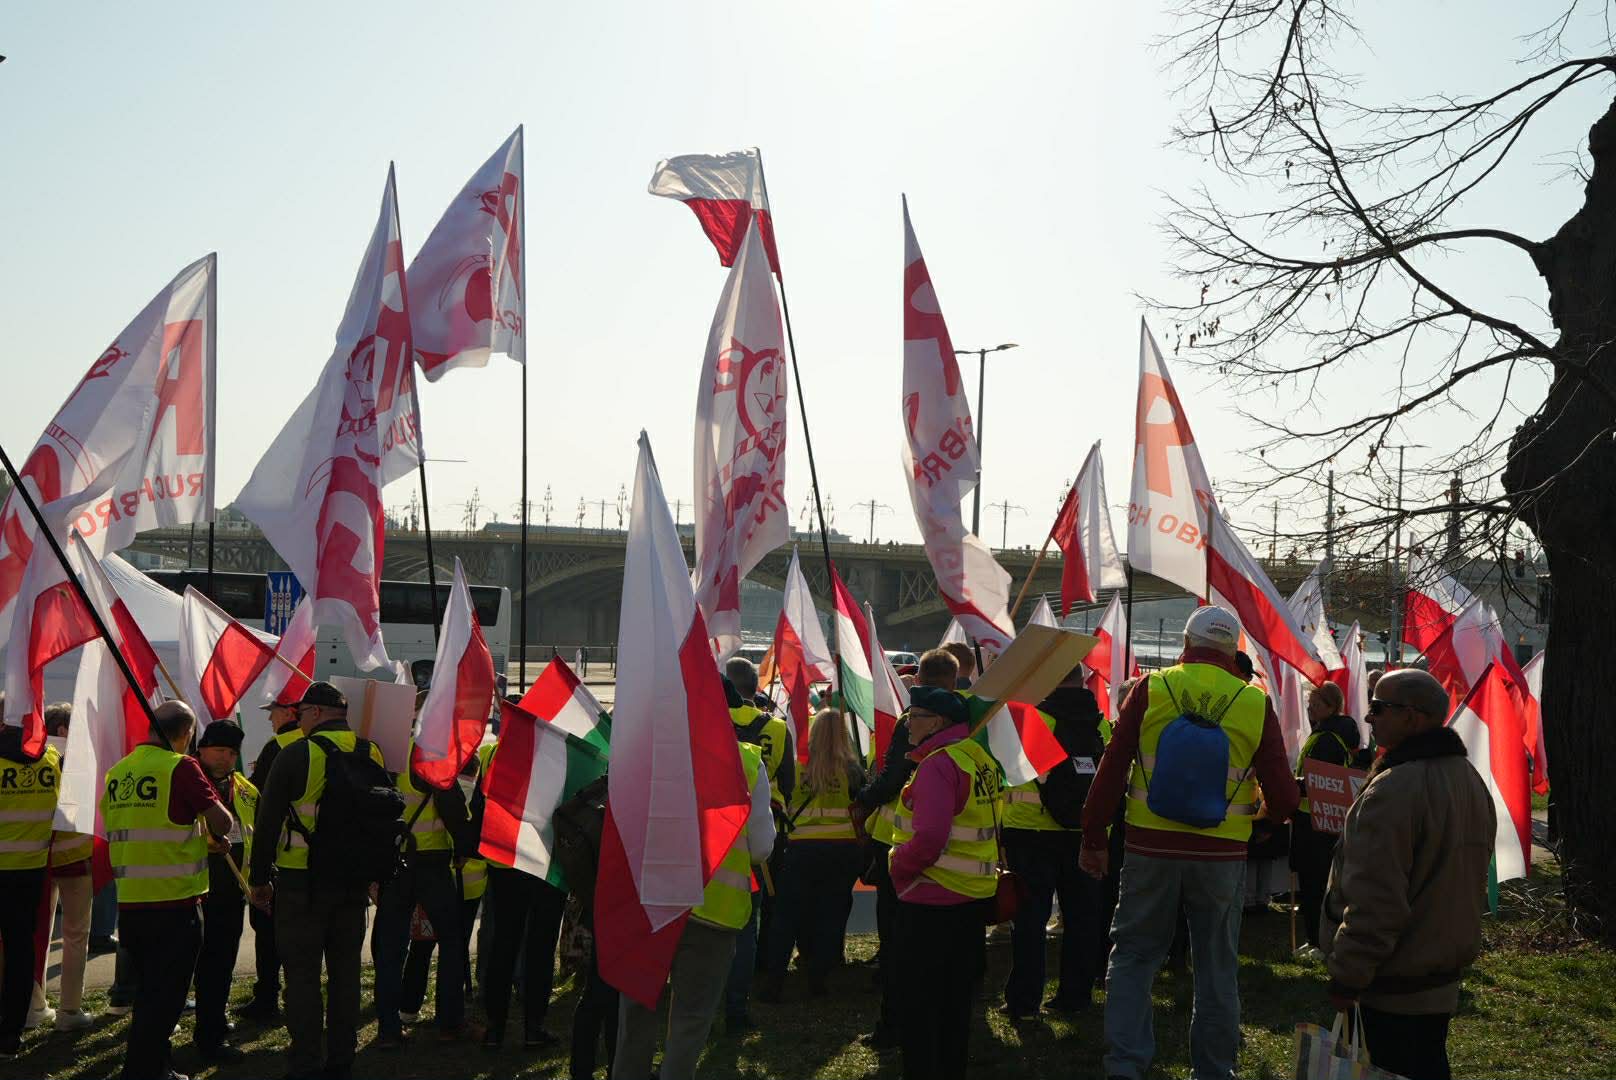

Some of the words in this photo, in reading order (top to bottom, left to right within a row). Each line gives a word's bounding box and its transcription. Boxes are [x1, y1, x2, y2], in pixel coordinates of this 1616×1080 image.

[1308, 773, 1345, 793] FIDESZ
[1313, 800, 1321, 814] A
[1323, 803, 1347, 818] BIZT
